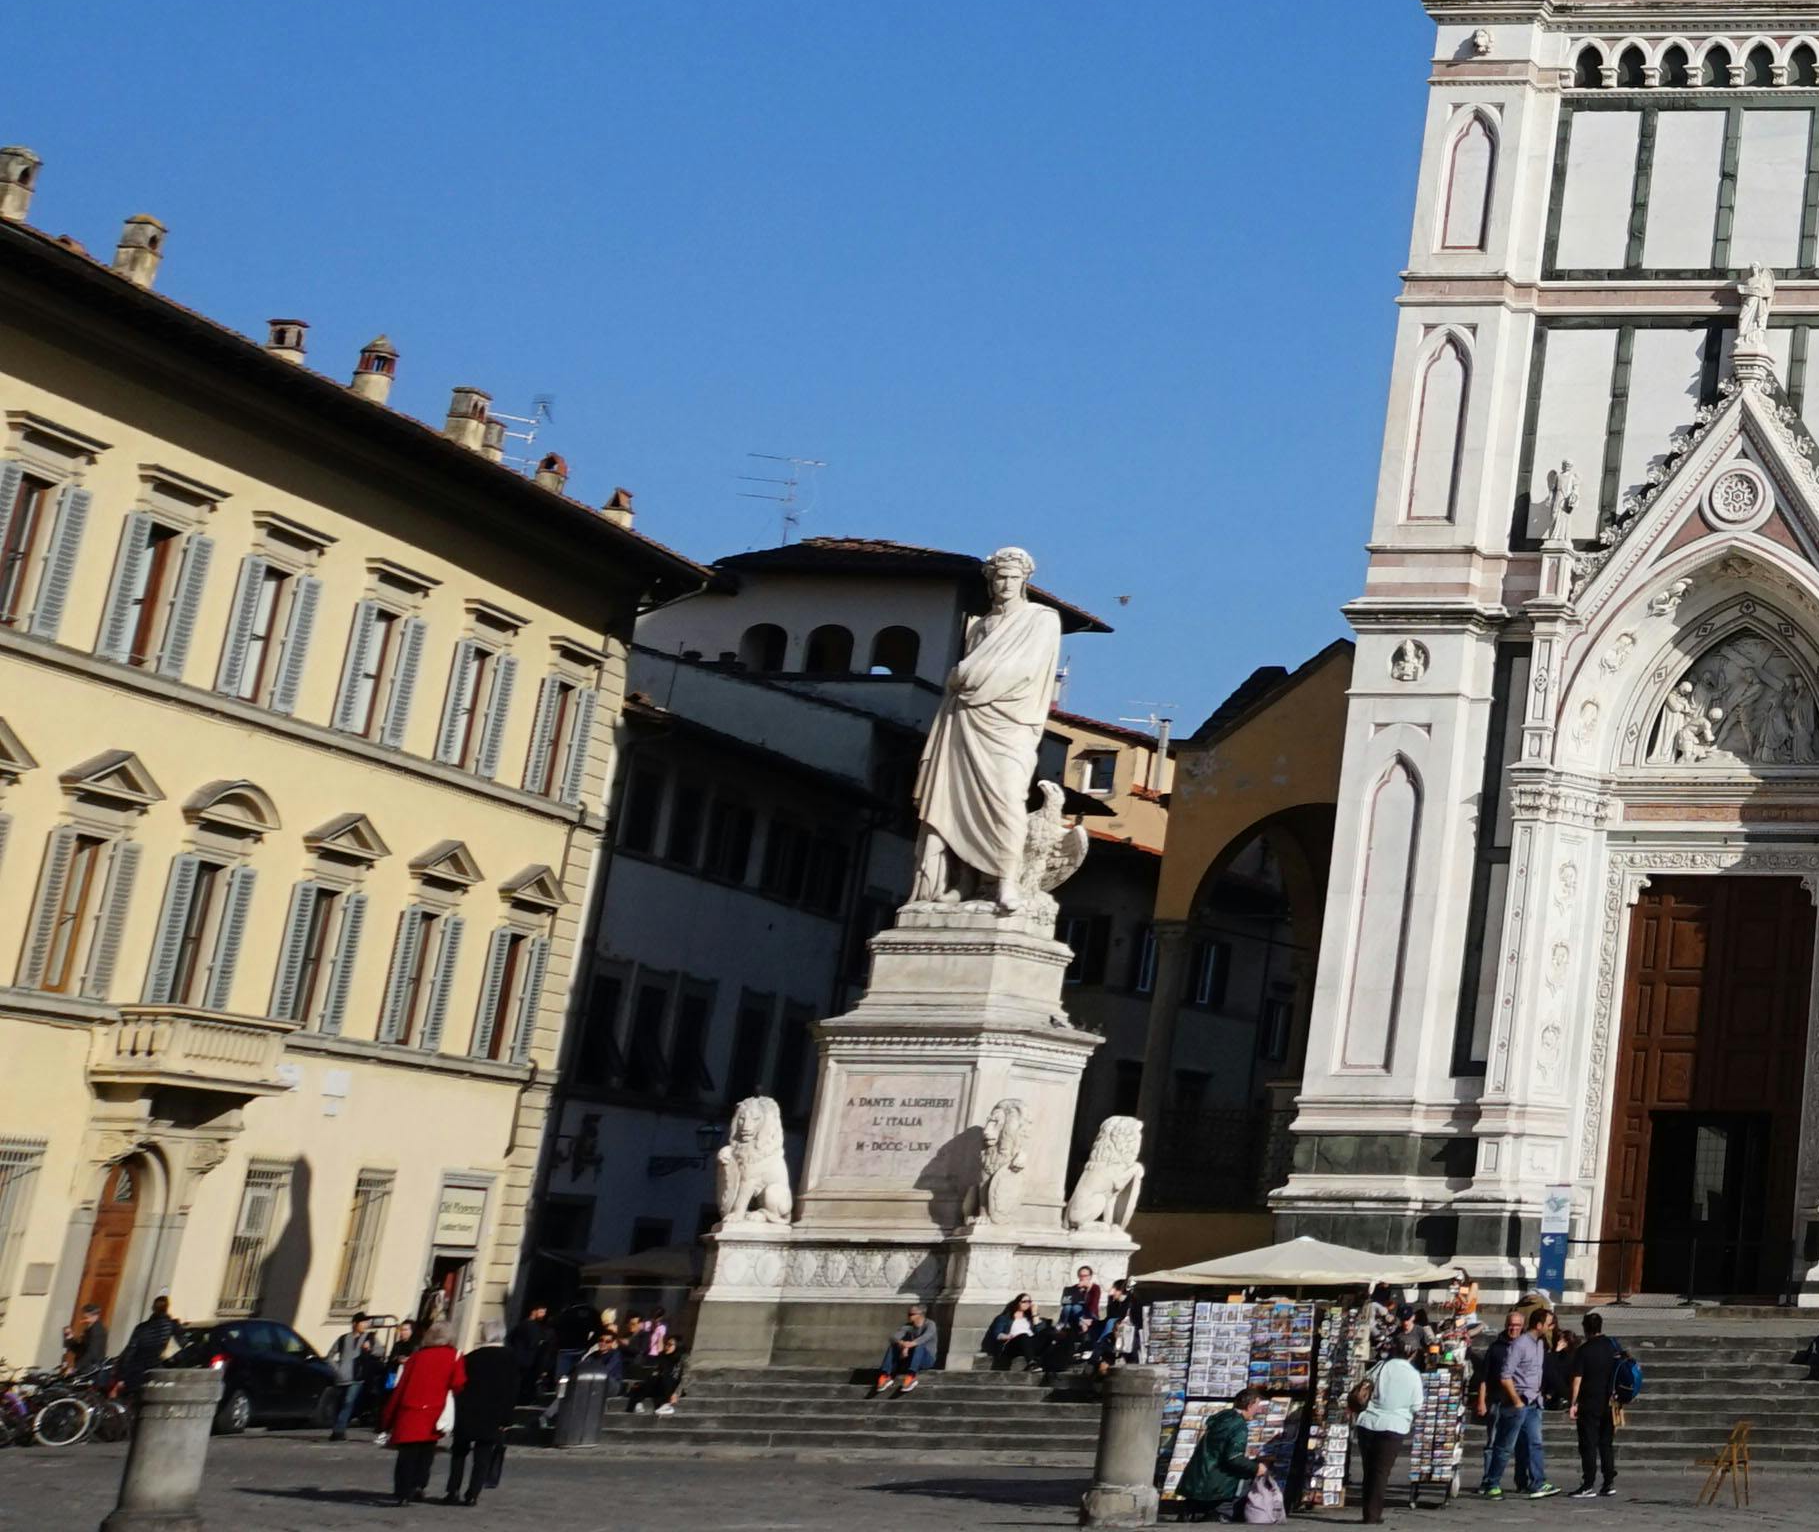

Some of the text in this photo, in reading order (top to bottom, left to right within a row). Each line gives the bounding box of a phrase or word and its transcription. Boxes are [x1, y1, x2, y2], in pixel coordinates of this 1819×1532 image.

[847, 1097, 956, 1108] A DANTE ALIGHIERI
